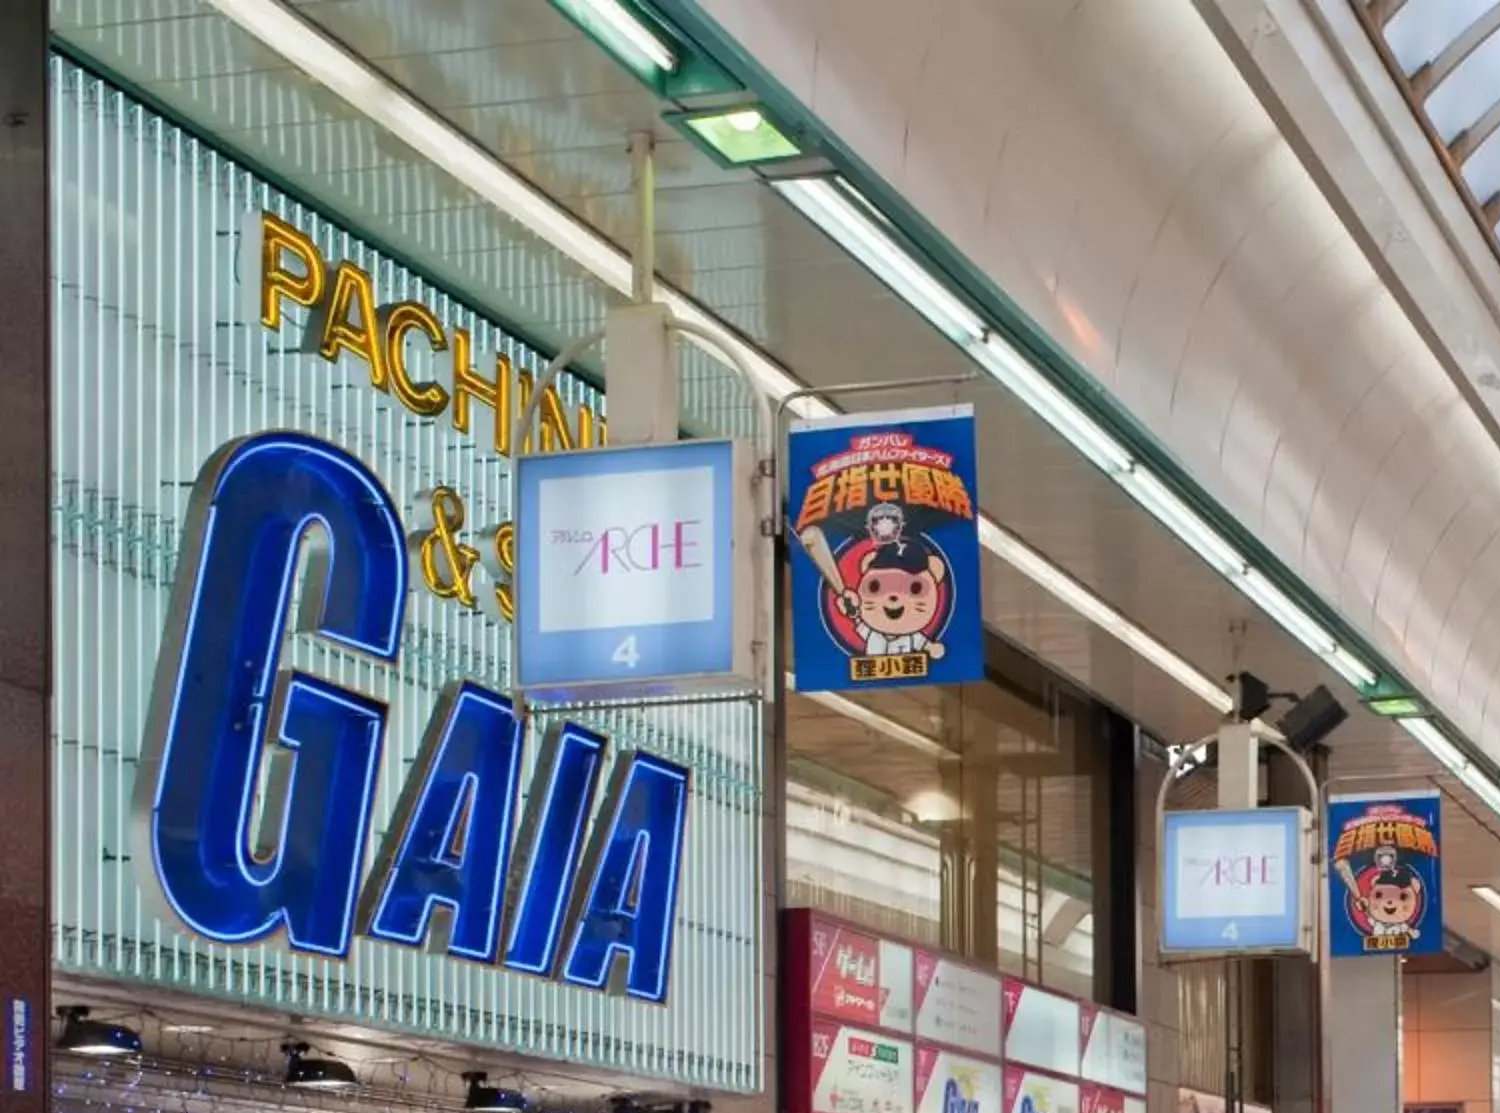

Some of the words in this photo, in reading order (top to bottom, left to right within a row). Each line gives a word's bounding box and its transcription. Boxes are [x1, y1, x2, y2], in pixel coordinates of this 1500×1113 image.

[261, 209, 609, 456] PACHIN
[797, 463, 973, 533] 目指せ優勝
[419, 484, 481, 606] &
[573, 520, 704, 576] ARCHE
[613, 635, 640, 669] 4
[152, 431, 692, 1004] GAIA
[1221, 921, 1239, 940] 4
